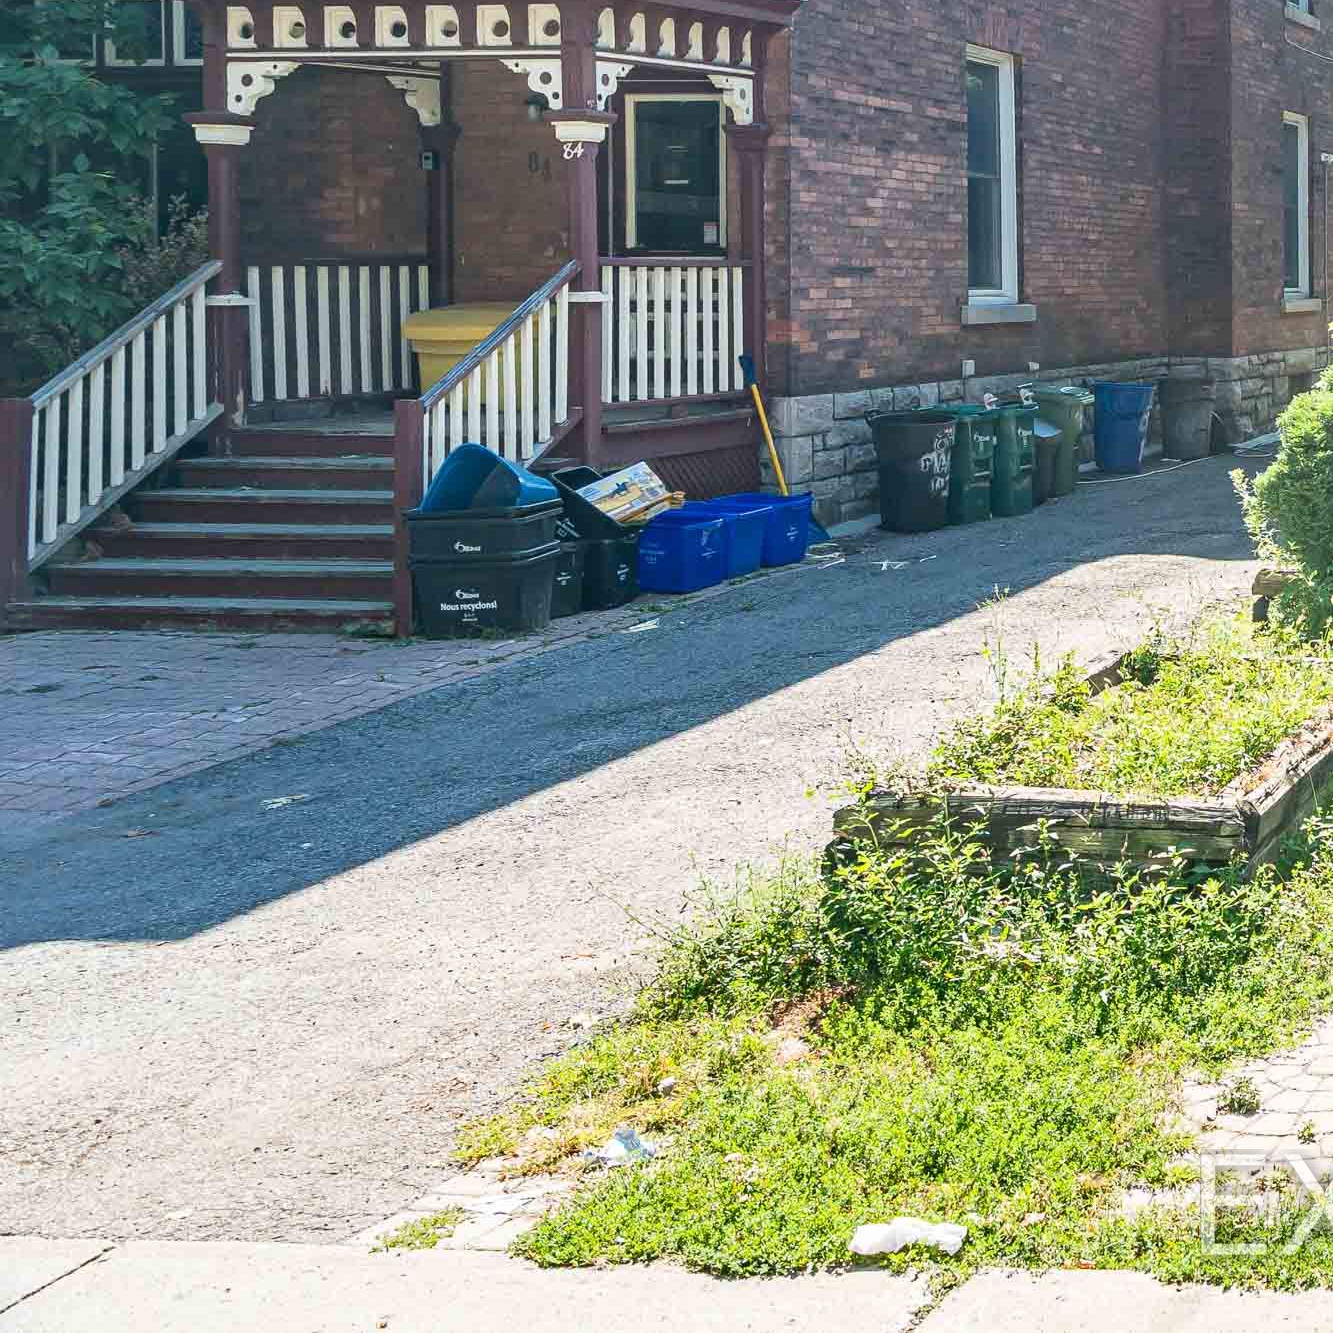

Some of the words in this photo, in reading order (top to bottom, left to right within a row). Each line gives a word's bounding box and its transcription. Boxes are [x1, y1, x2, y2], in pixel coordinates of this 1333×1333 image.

[563, 141, 584, 160] 84
[440, 602, 460, 611] Nous
[460, 600, 497, 612] recyclons!
